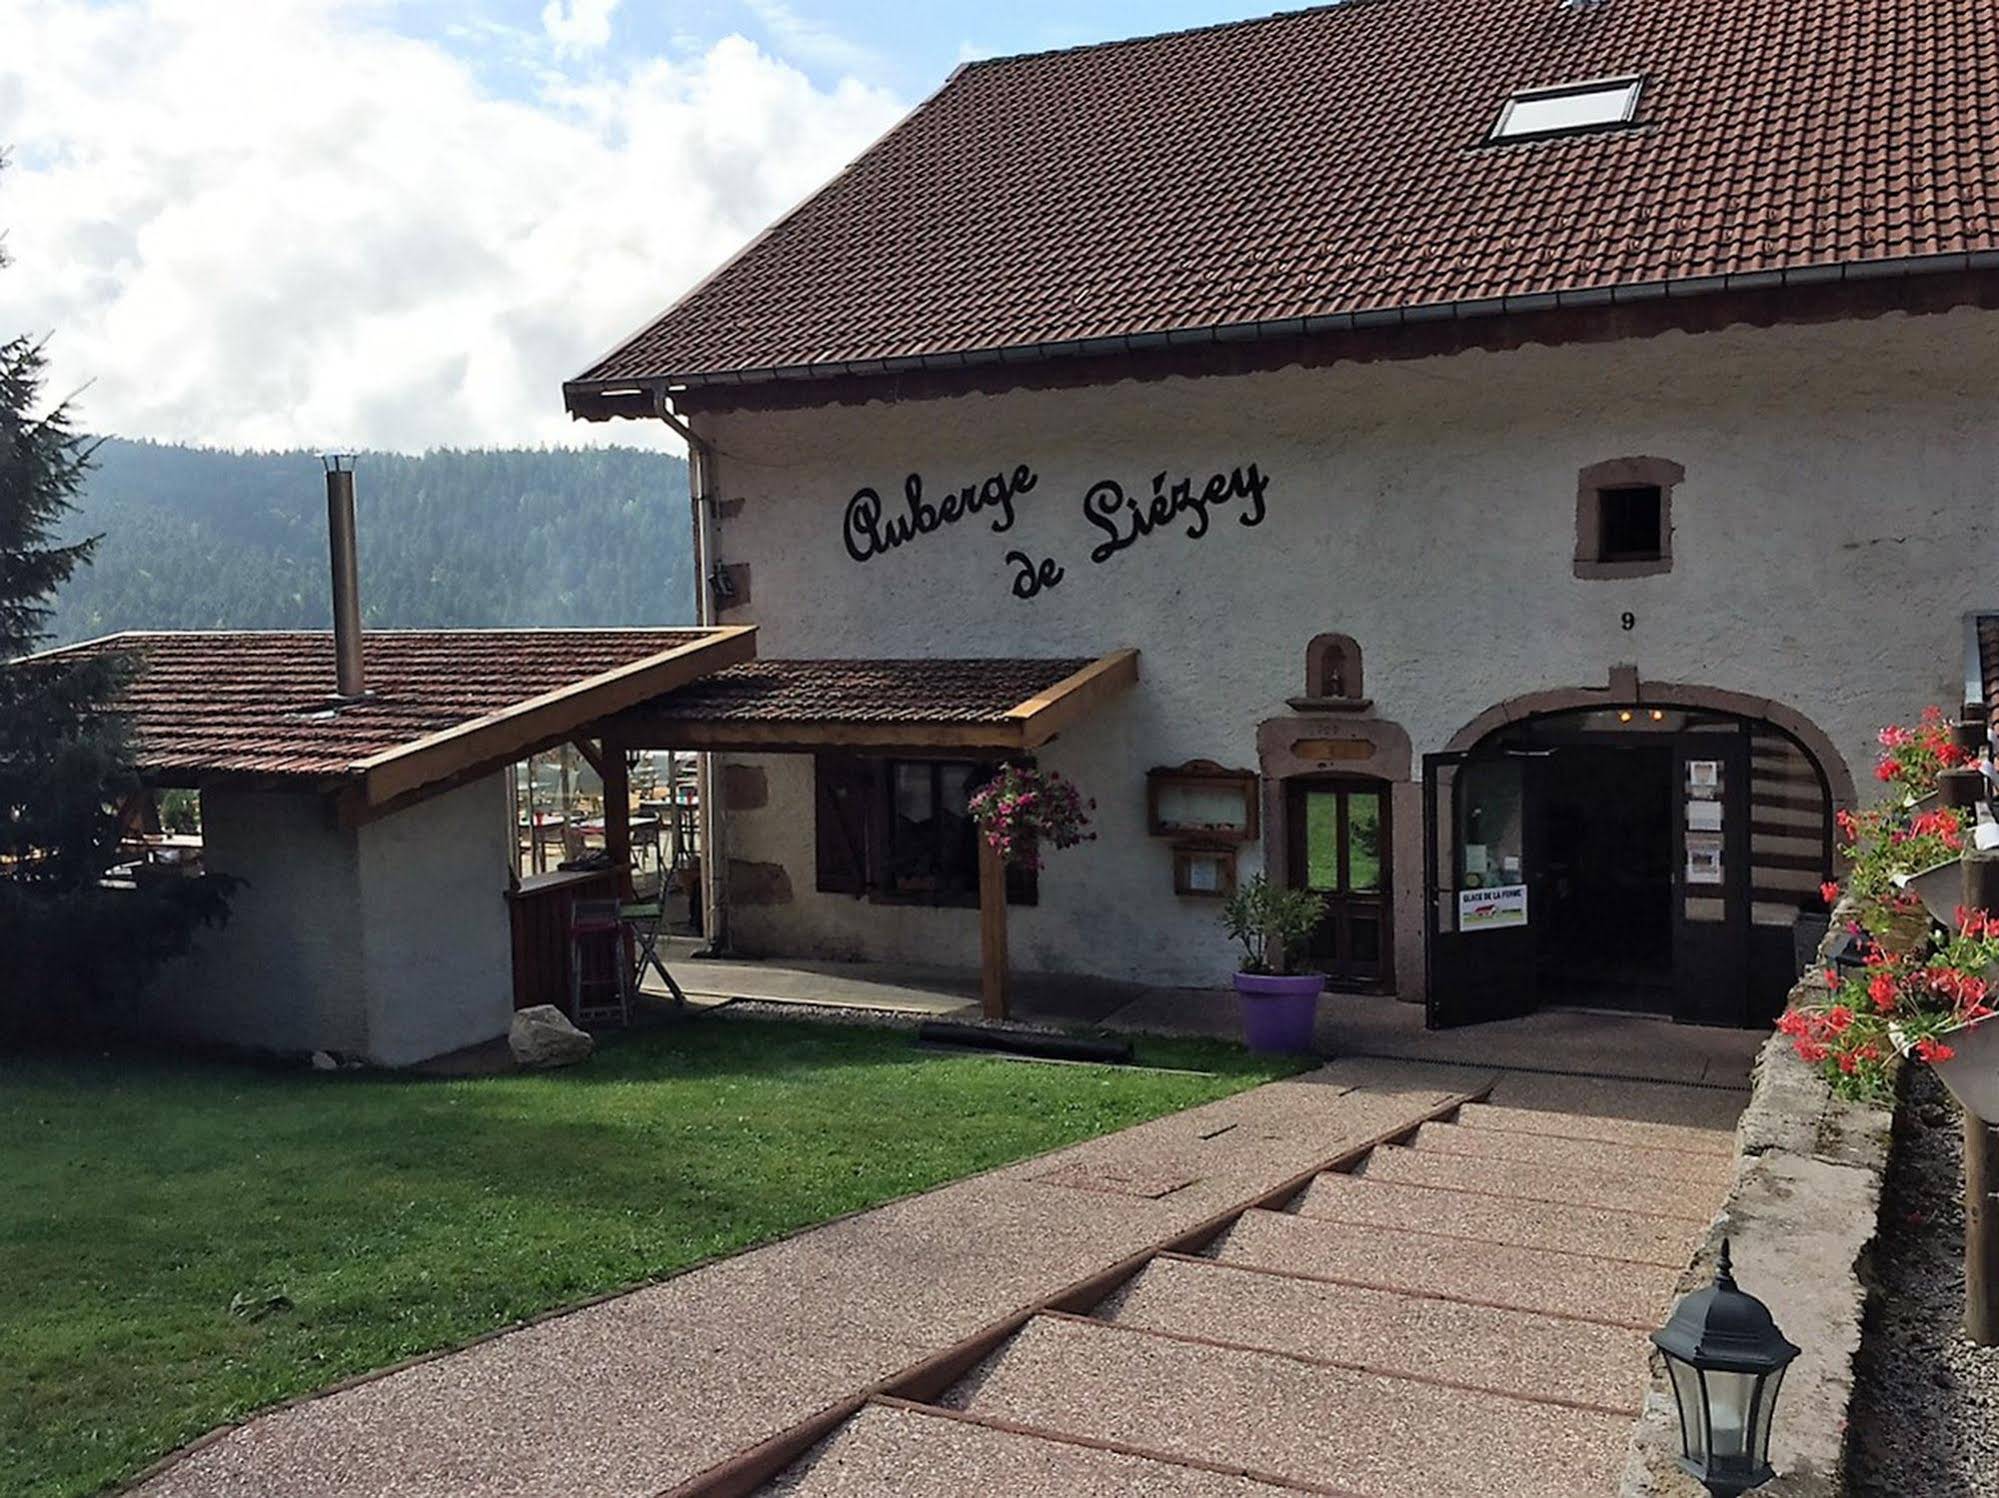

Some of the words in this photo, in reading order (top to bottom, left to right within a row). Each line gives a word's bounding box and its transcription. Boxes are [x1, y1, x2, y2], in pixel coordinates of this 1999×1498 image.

[843, 464, 1038, 562] Auberge
[1006, 550, 1065, 599] de
[1083, 463, 1270, 563] Liézey
[1620, 612, 1635, 631] 9
[1463, 892, 1482, 903] GLACE
[1484, 892, 1492, 901] DE
[1493, 891, 1500, 900] LA
